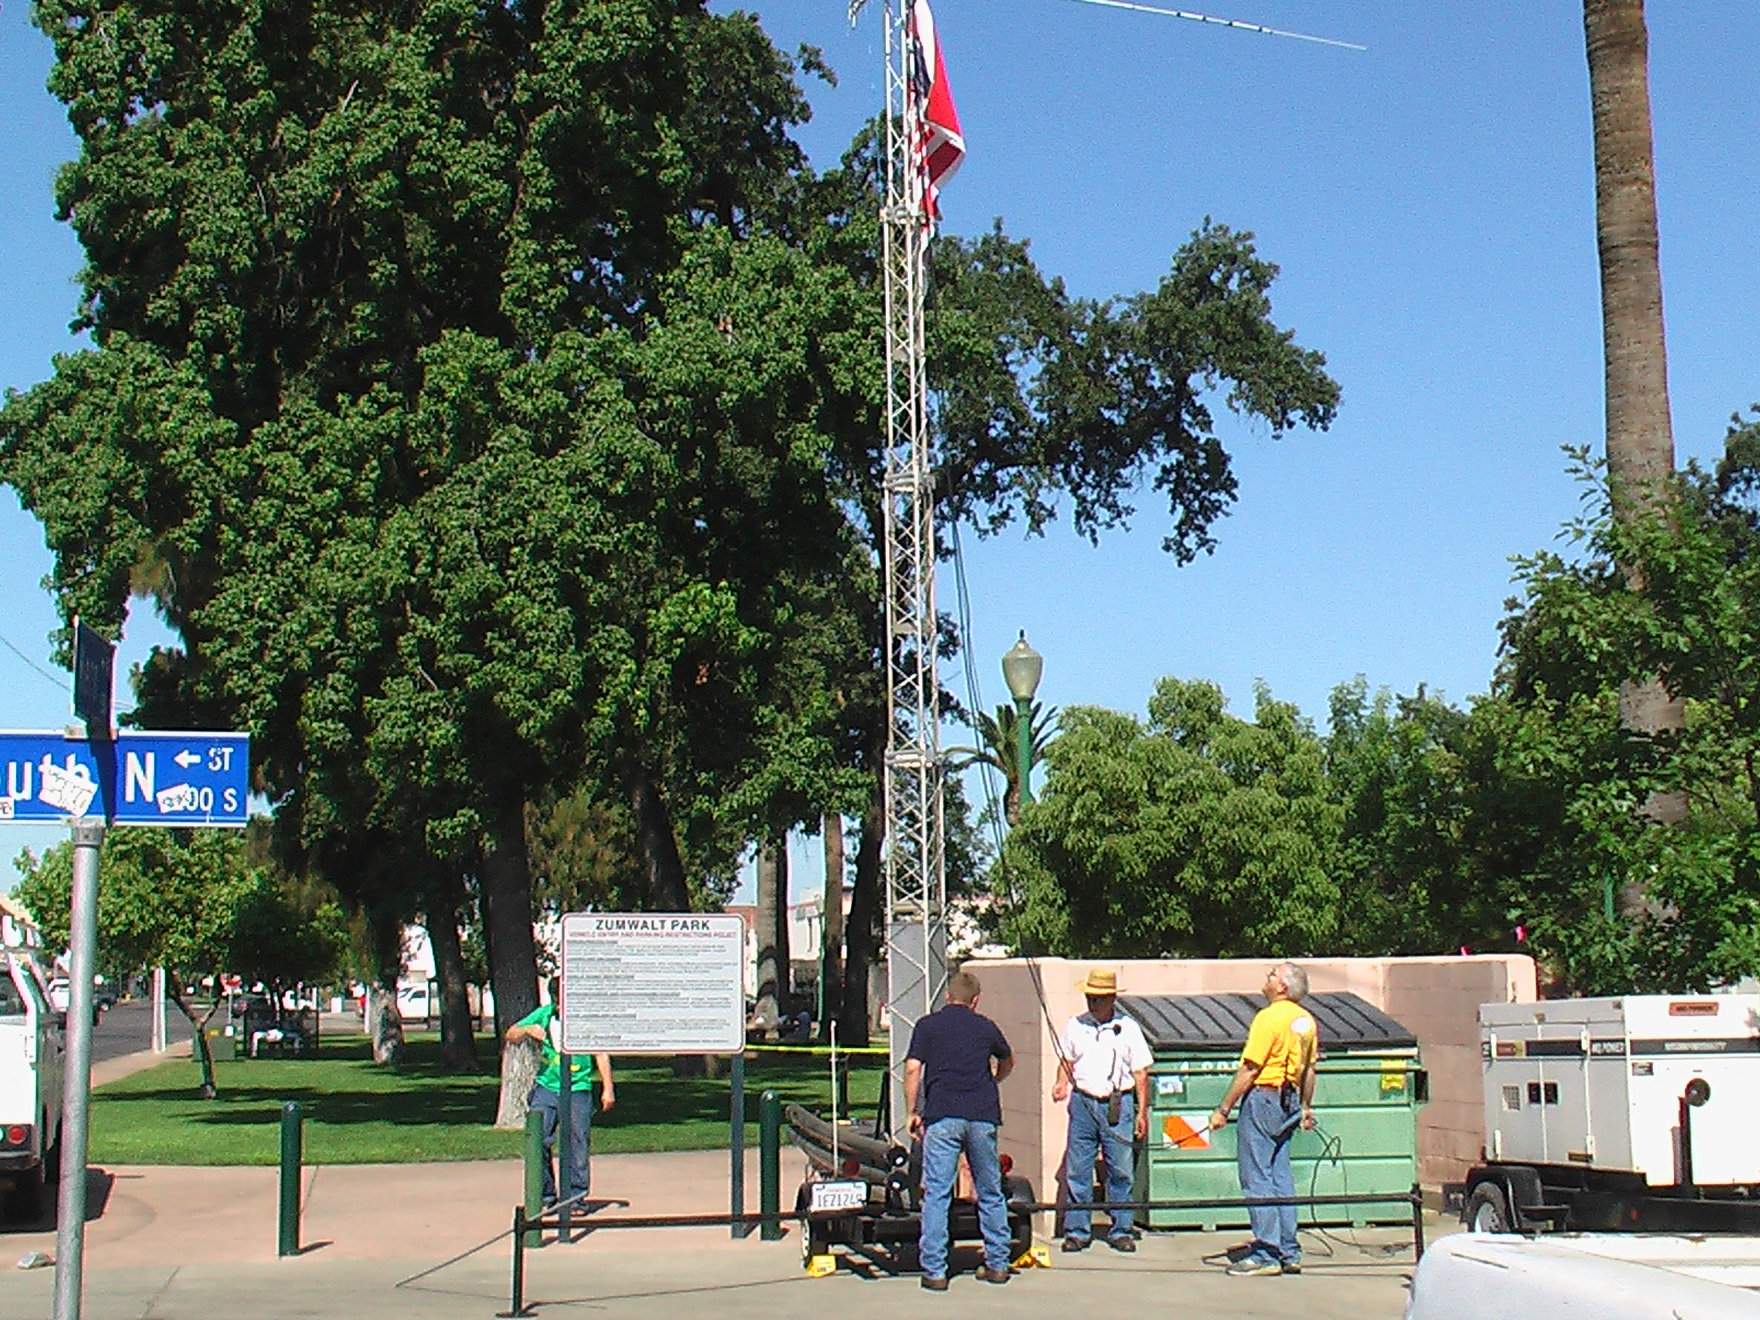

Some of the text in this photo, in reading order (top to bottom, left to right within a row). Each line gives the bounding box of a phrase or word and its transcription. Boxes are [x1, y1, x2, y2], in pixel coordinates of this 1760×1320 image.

[0, 753, 91, 801] uth
[125, 751, 155, 803] N
[208, 747, 234, 771] ST
[174, 786, 214, 811] 00
[223, 787, 238, 812] S
[596, 919, 710, 931] ZUMWALT PARK
